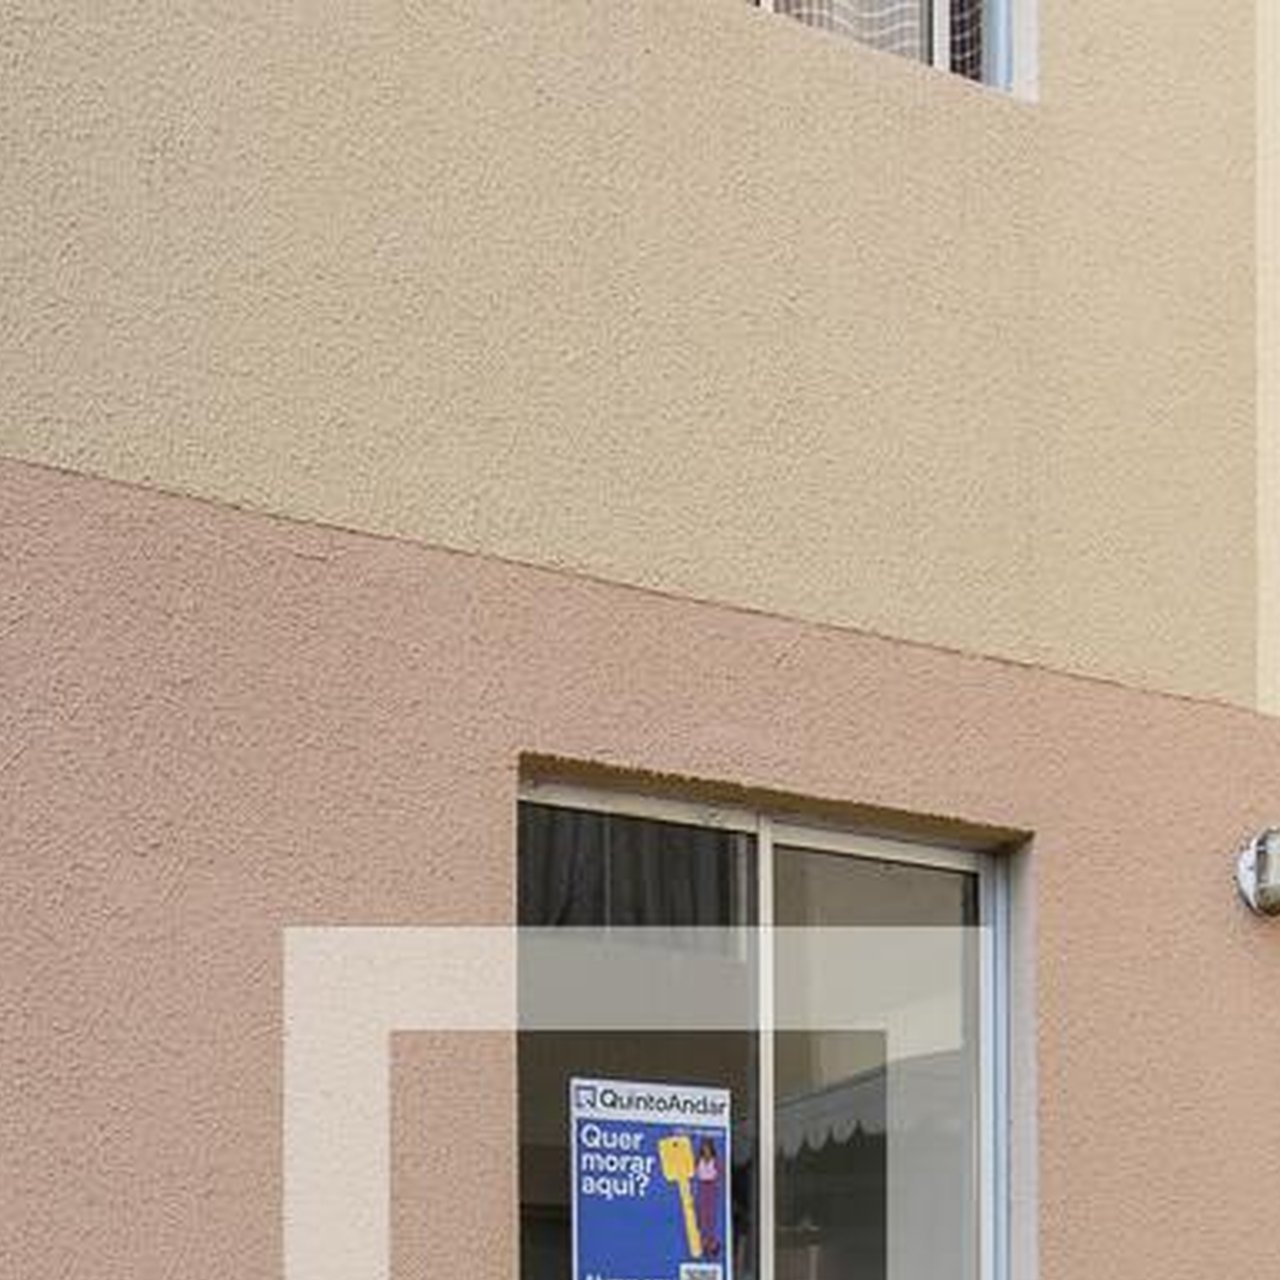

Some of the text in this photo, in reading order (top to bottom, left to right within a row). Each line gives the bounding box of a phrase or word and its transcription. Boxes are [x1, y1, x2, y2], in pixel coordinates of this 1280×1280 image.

[600, 1089, 726, 1115] QuintoAndar
[580, 1124, 644, 1150] Quer
[581, 1152, 655, 1174] morar
[581, 1173, 650, 1200] aqui?
